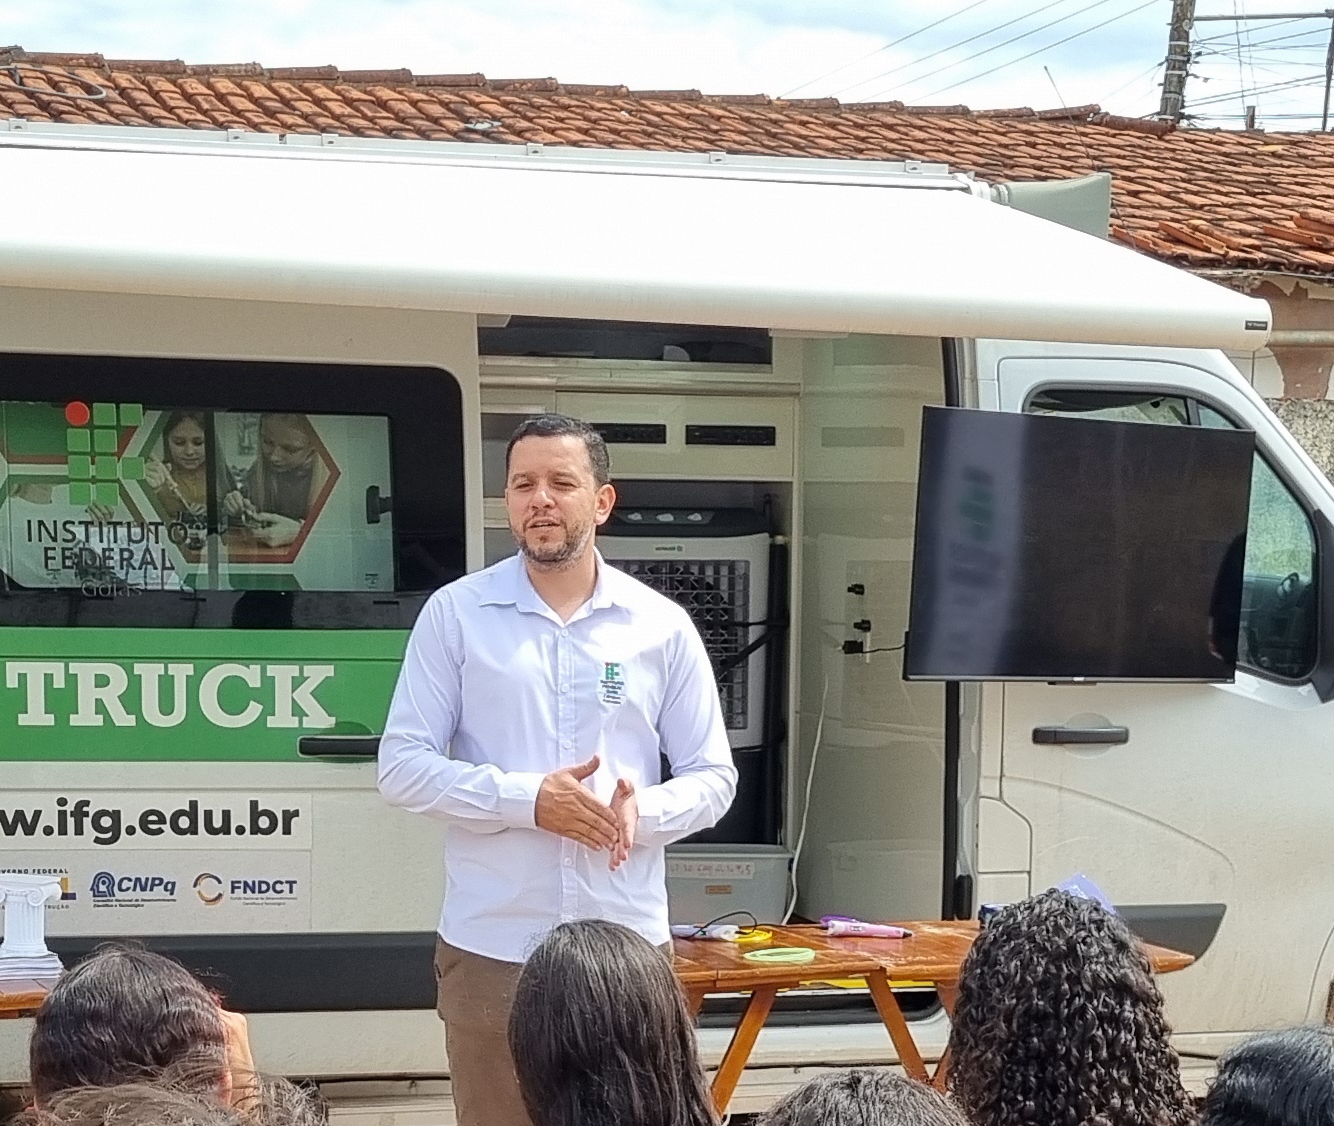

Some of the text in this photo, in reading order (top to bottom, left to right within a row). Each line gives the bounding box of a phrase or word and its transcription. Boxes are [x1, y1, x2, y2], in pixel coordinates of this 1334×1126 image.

[27, 519, 189, 545] INSTITUTO
[44, 546, 175, 571] FEDERAL
[5, 661, 336, 729] TRUCK
[117, 876, 177, 896] CNPq
[230, 880, 298, 895] FNDCT
